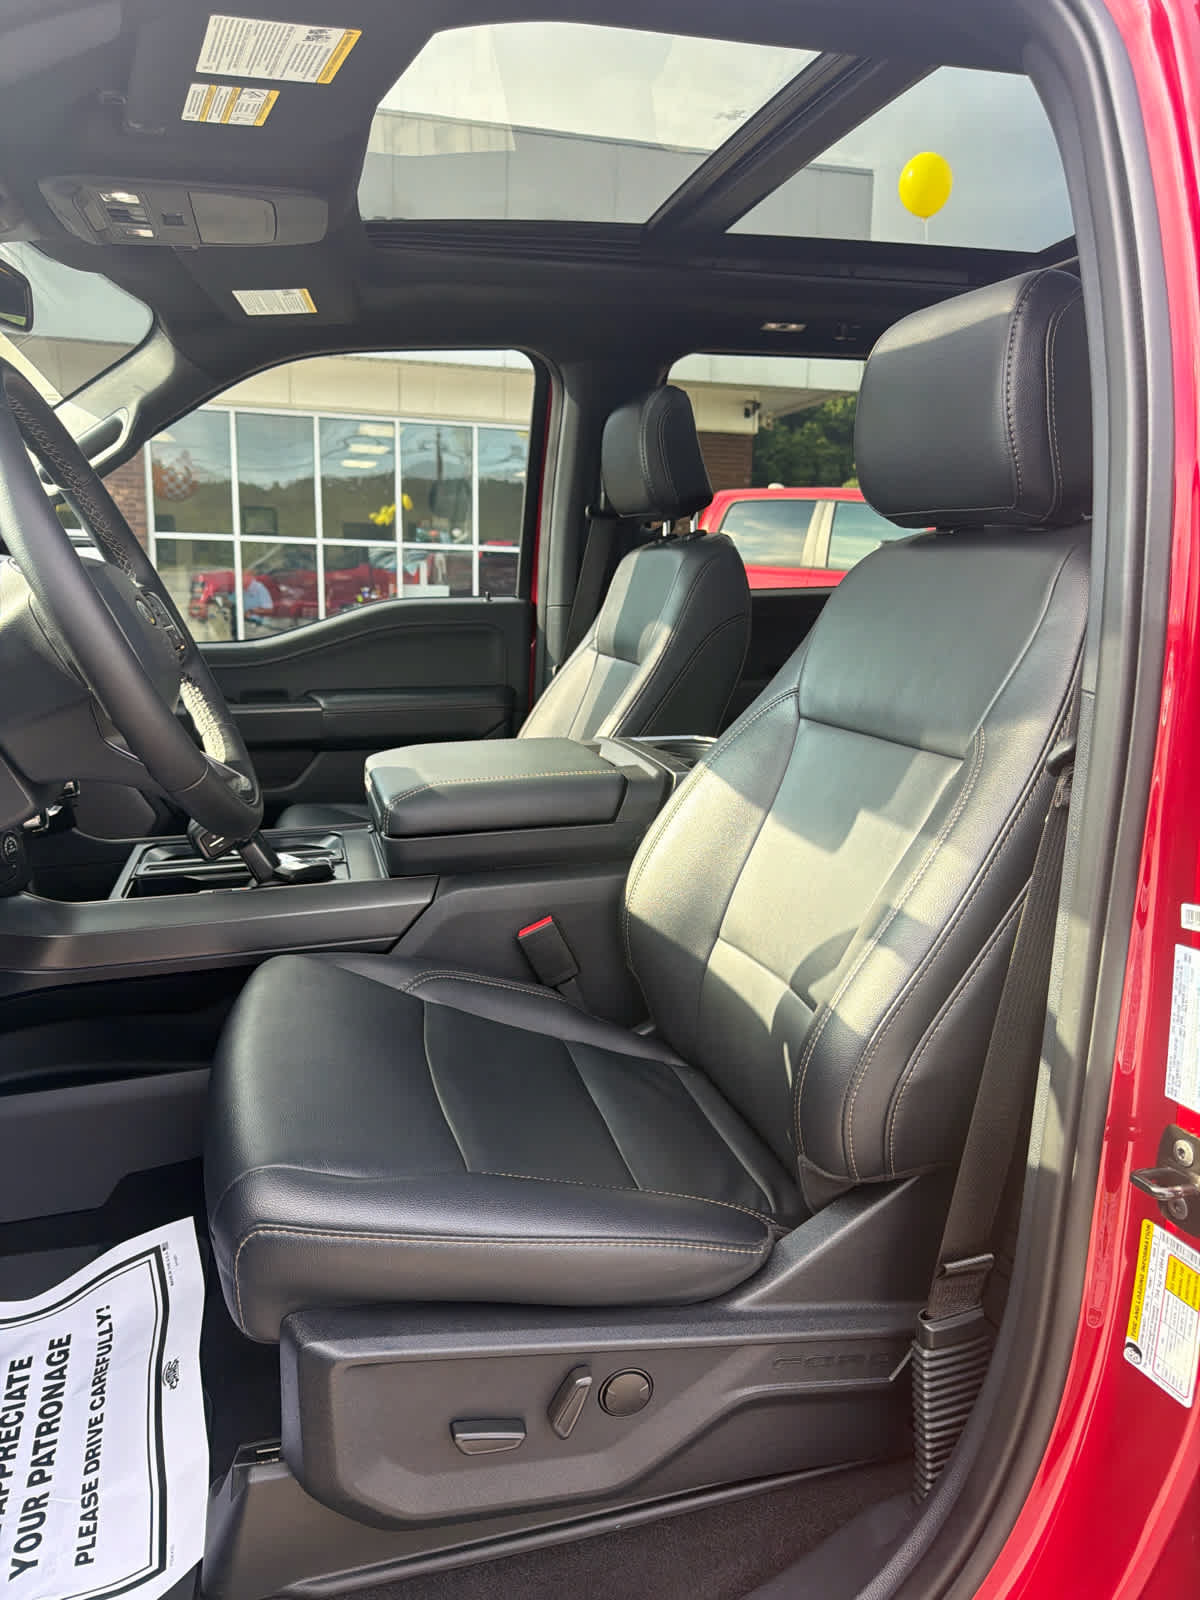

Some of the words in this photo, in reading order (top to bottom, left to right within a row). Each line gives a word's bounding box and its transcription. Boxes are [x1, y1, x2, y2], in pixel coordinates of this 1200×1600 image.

[89, 1305, 114, 1411] CAREFULLY!
[26, 1333, 72, 1488] PATRONAGE
[83, 1411, 105, 1473] DRIVE
[8, 1492, 50, 1582] YOUR
[75, 1476, 99, 1567] PLEASE
